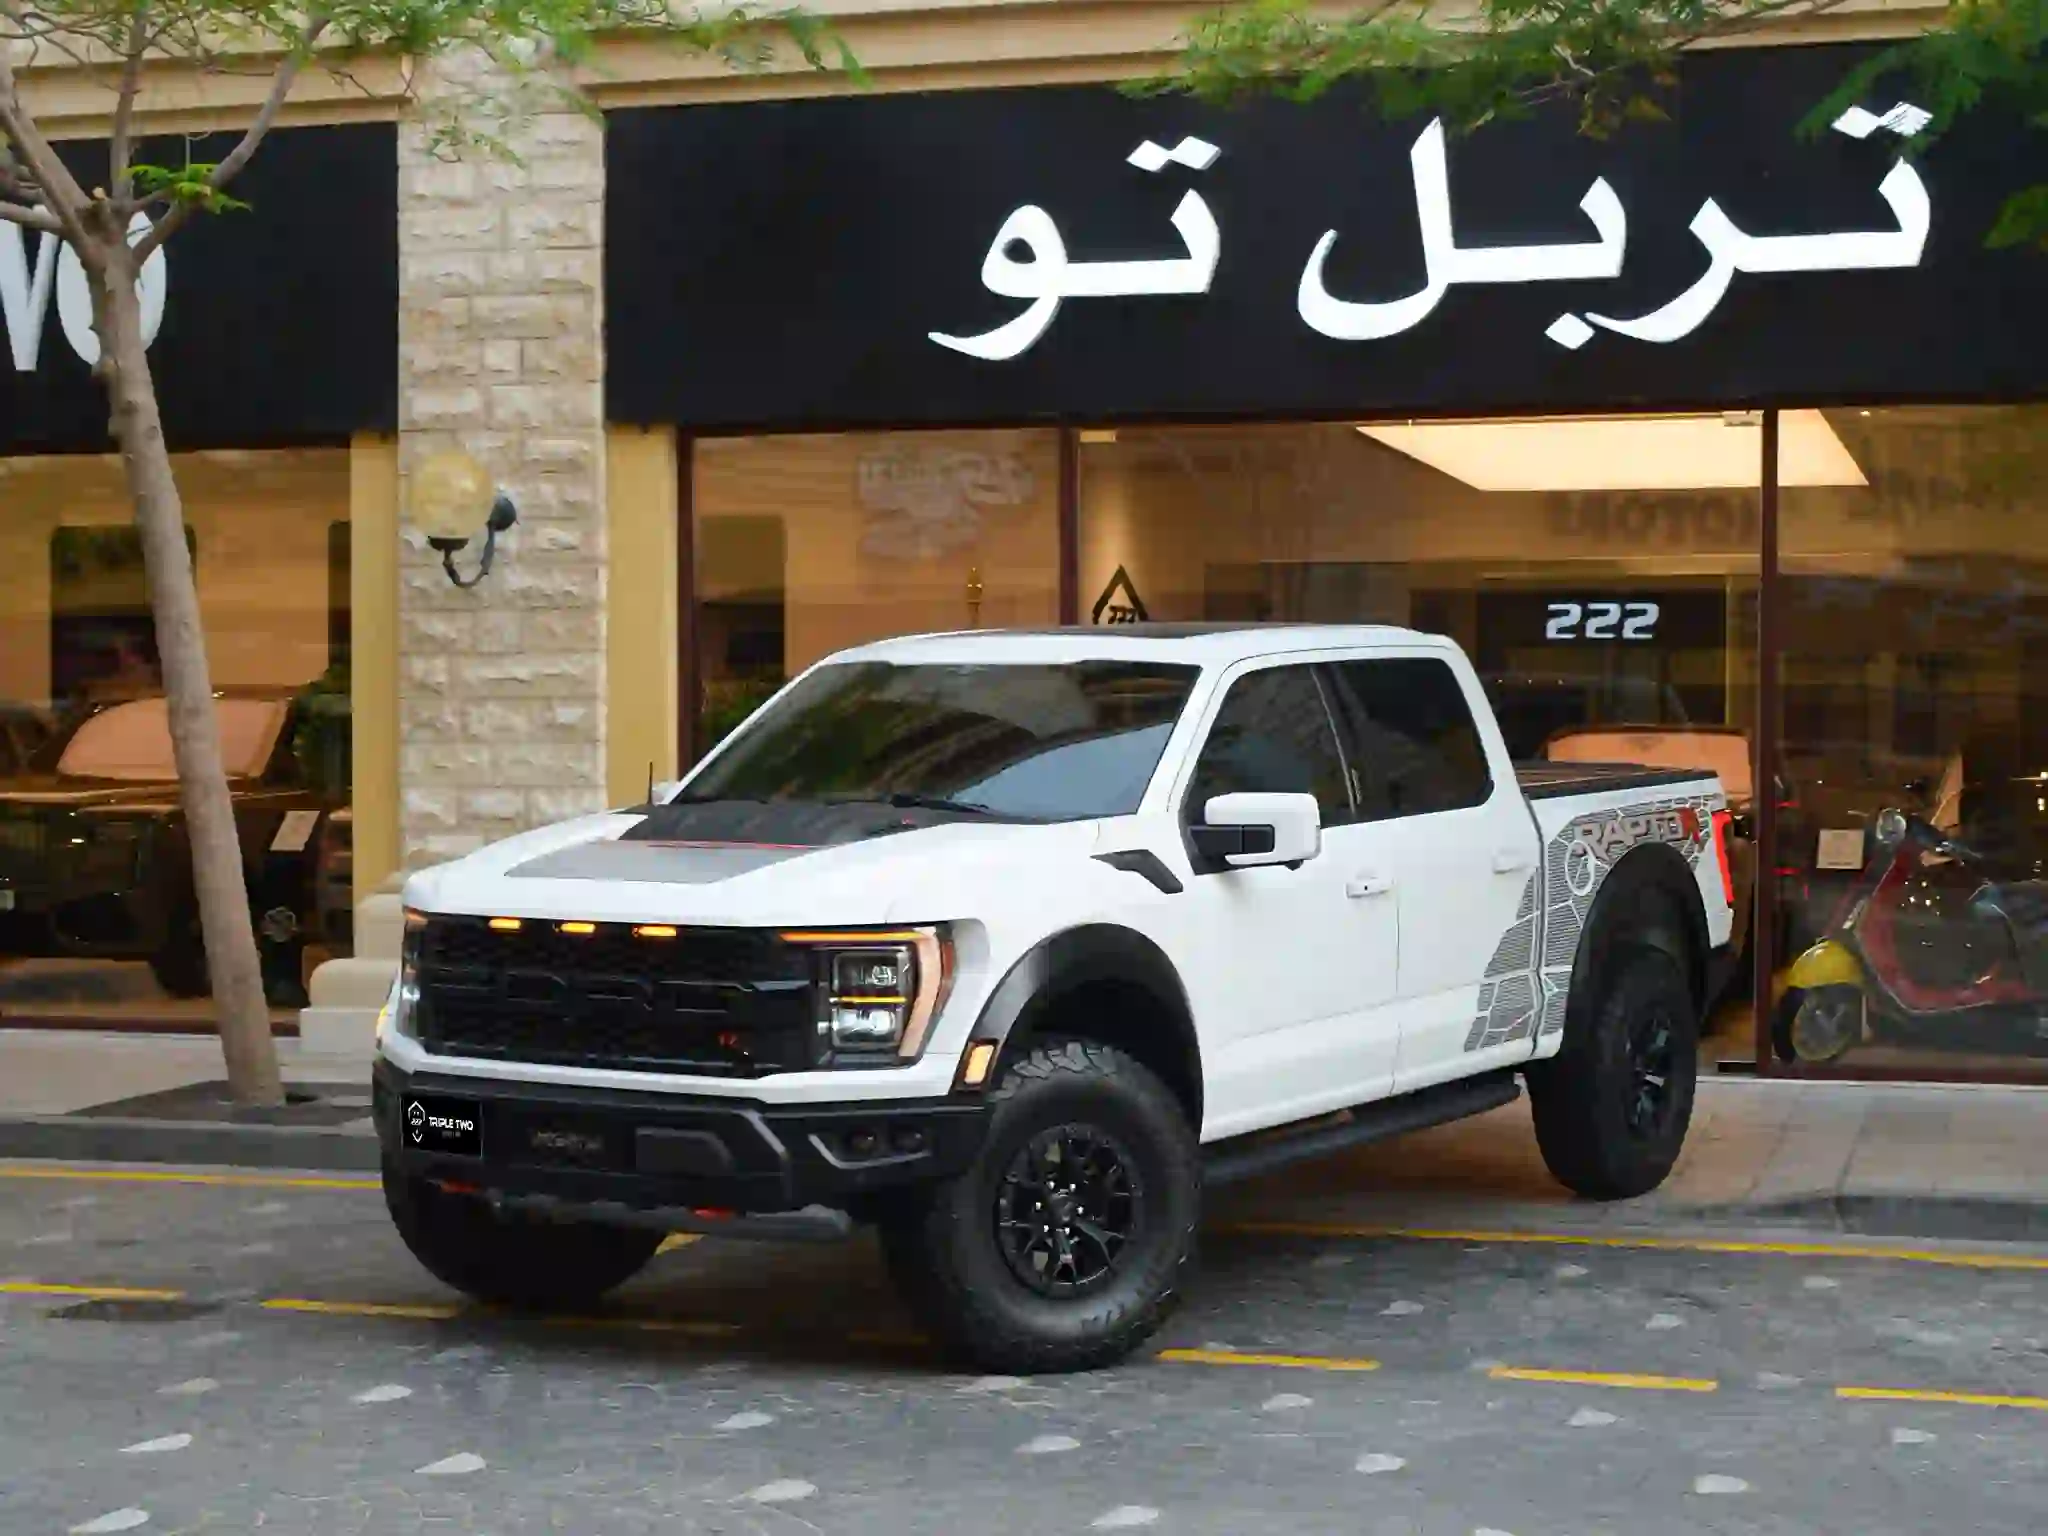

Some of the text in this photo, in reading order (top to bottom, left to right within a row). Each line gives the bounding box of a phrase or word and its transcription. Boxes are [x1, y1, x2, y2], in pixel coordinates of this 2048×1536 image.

[928, 101, 1932, 360] تربل تو
[1546, 603, 1660, 640] 222
[1573, 806, 1701, 865] RAPTOR
[429, 1116, 474, 1131] TRIPLE TWO
